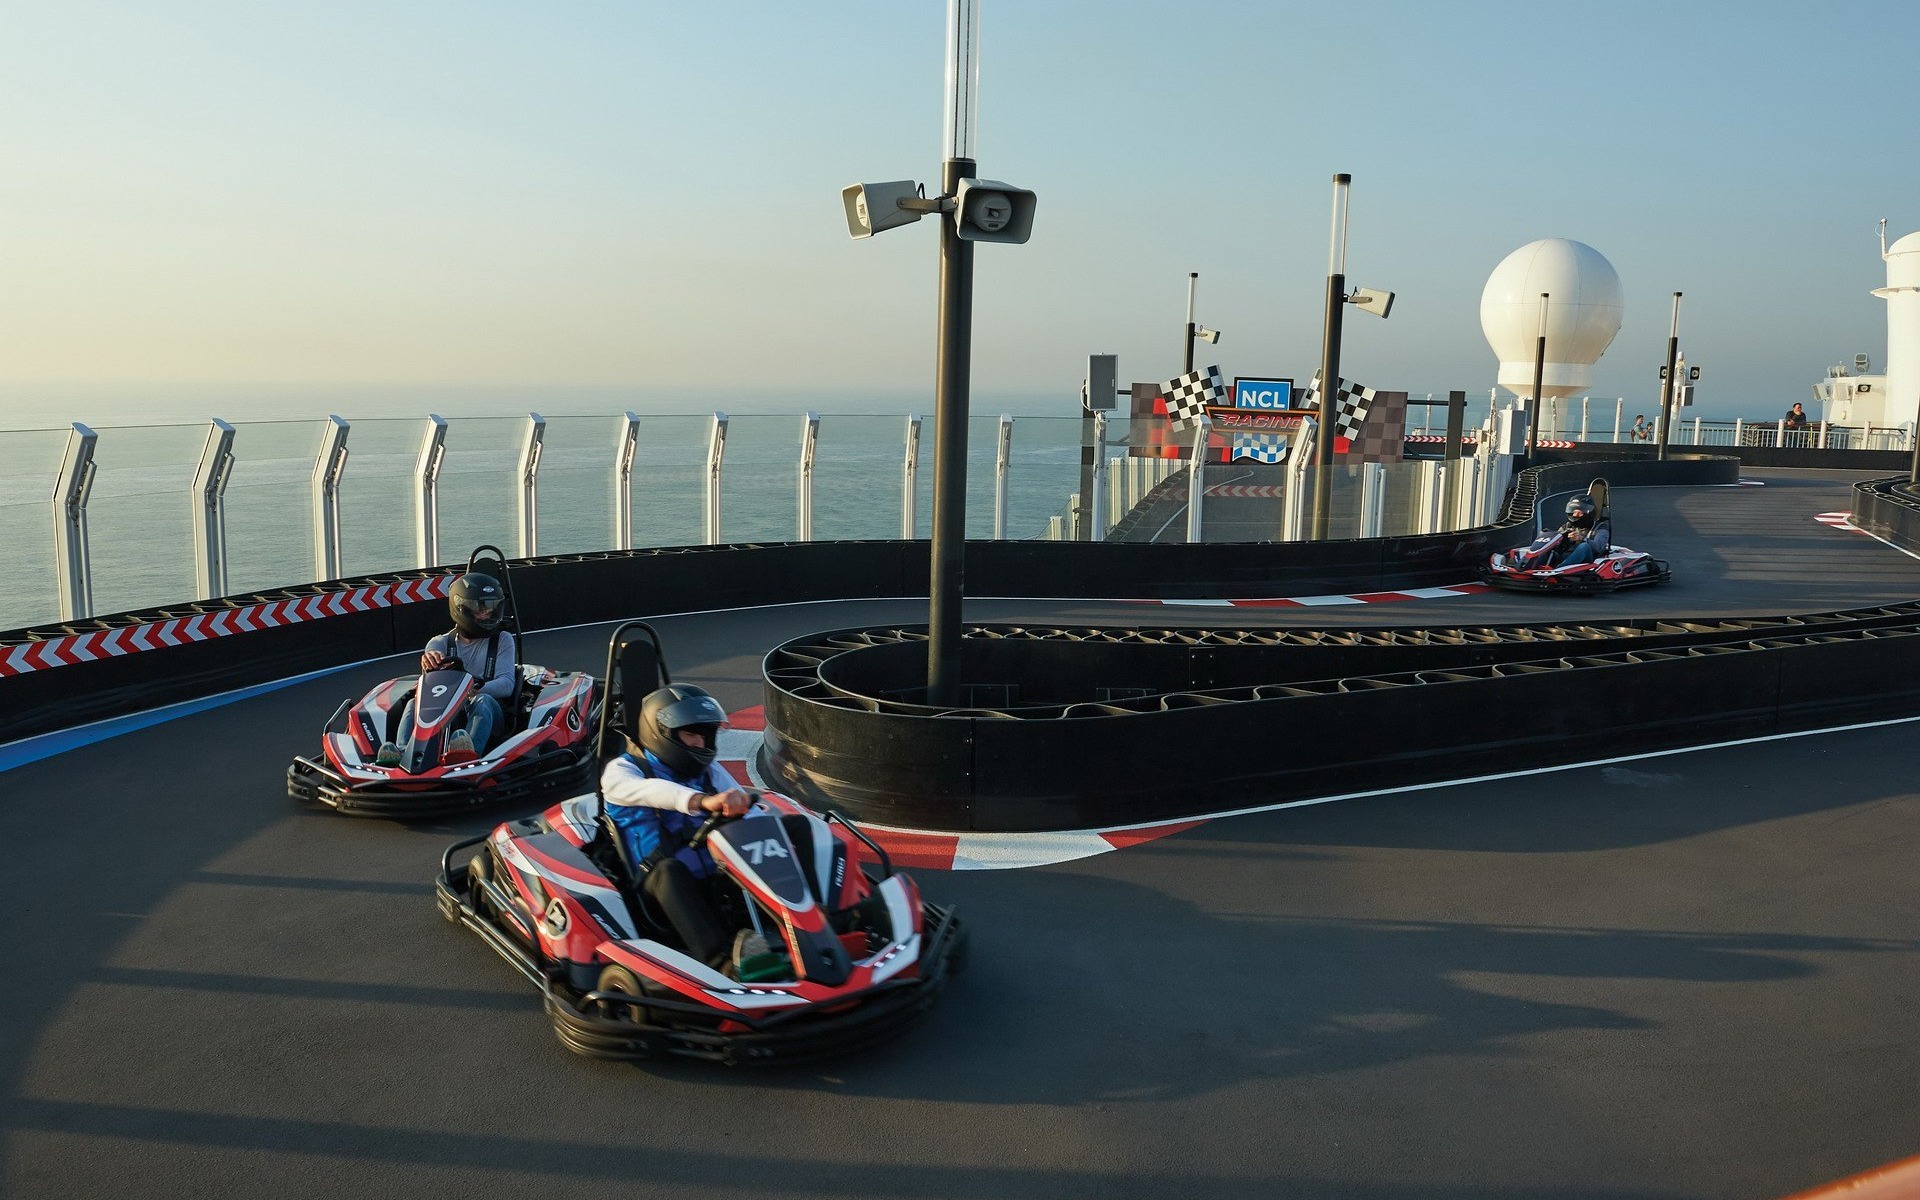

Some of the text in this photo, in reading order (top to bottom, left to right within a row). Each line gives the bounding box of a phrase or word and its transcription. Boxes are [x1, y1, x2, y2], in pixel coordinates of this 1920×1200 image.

[1241, 390, 1286, 409] NCL
[1221, 413, 1303, 430] RACING
[431, 684, 448, 698] 9
[740, 838, 789, 866] 74
